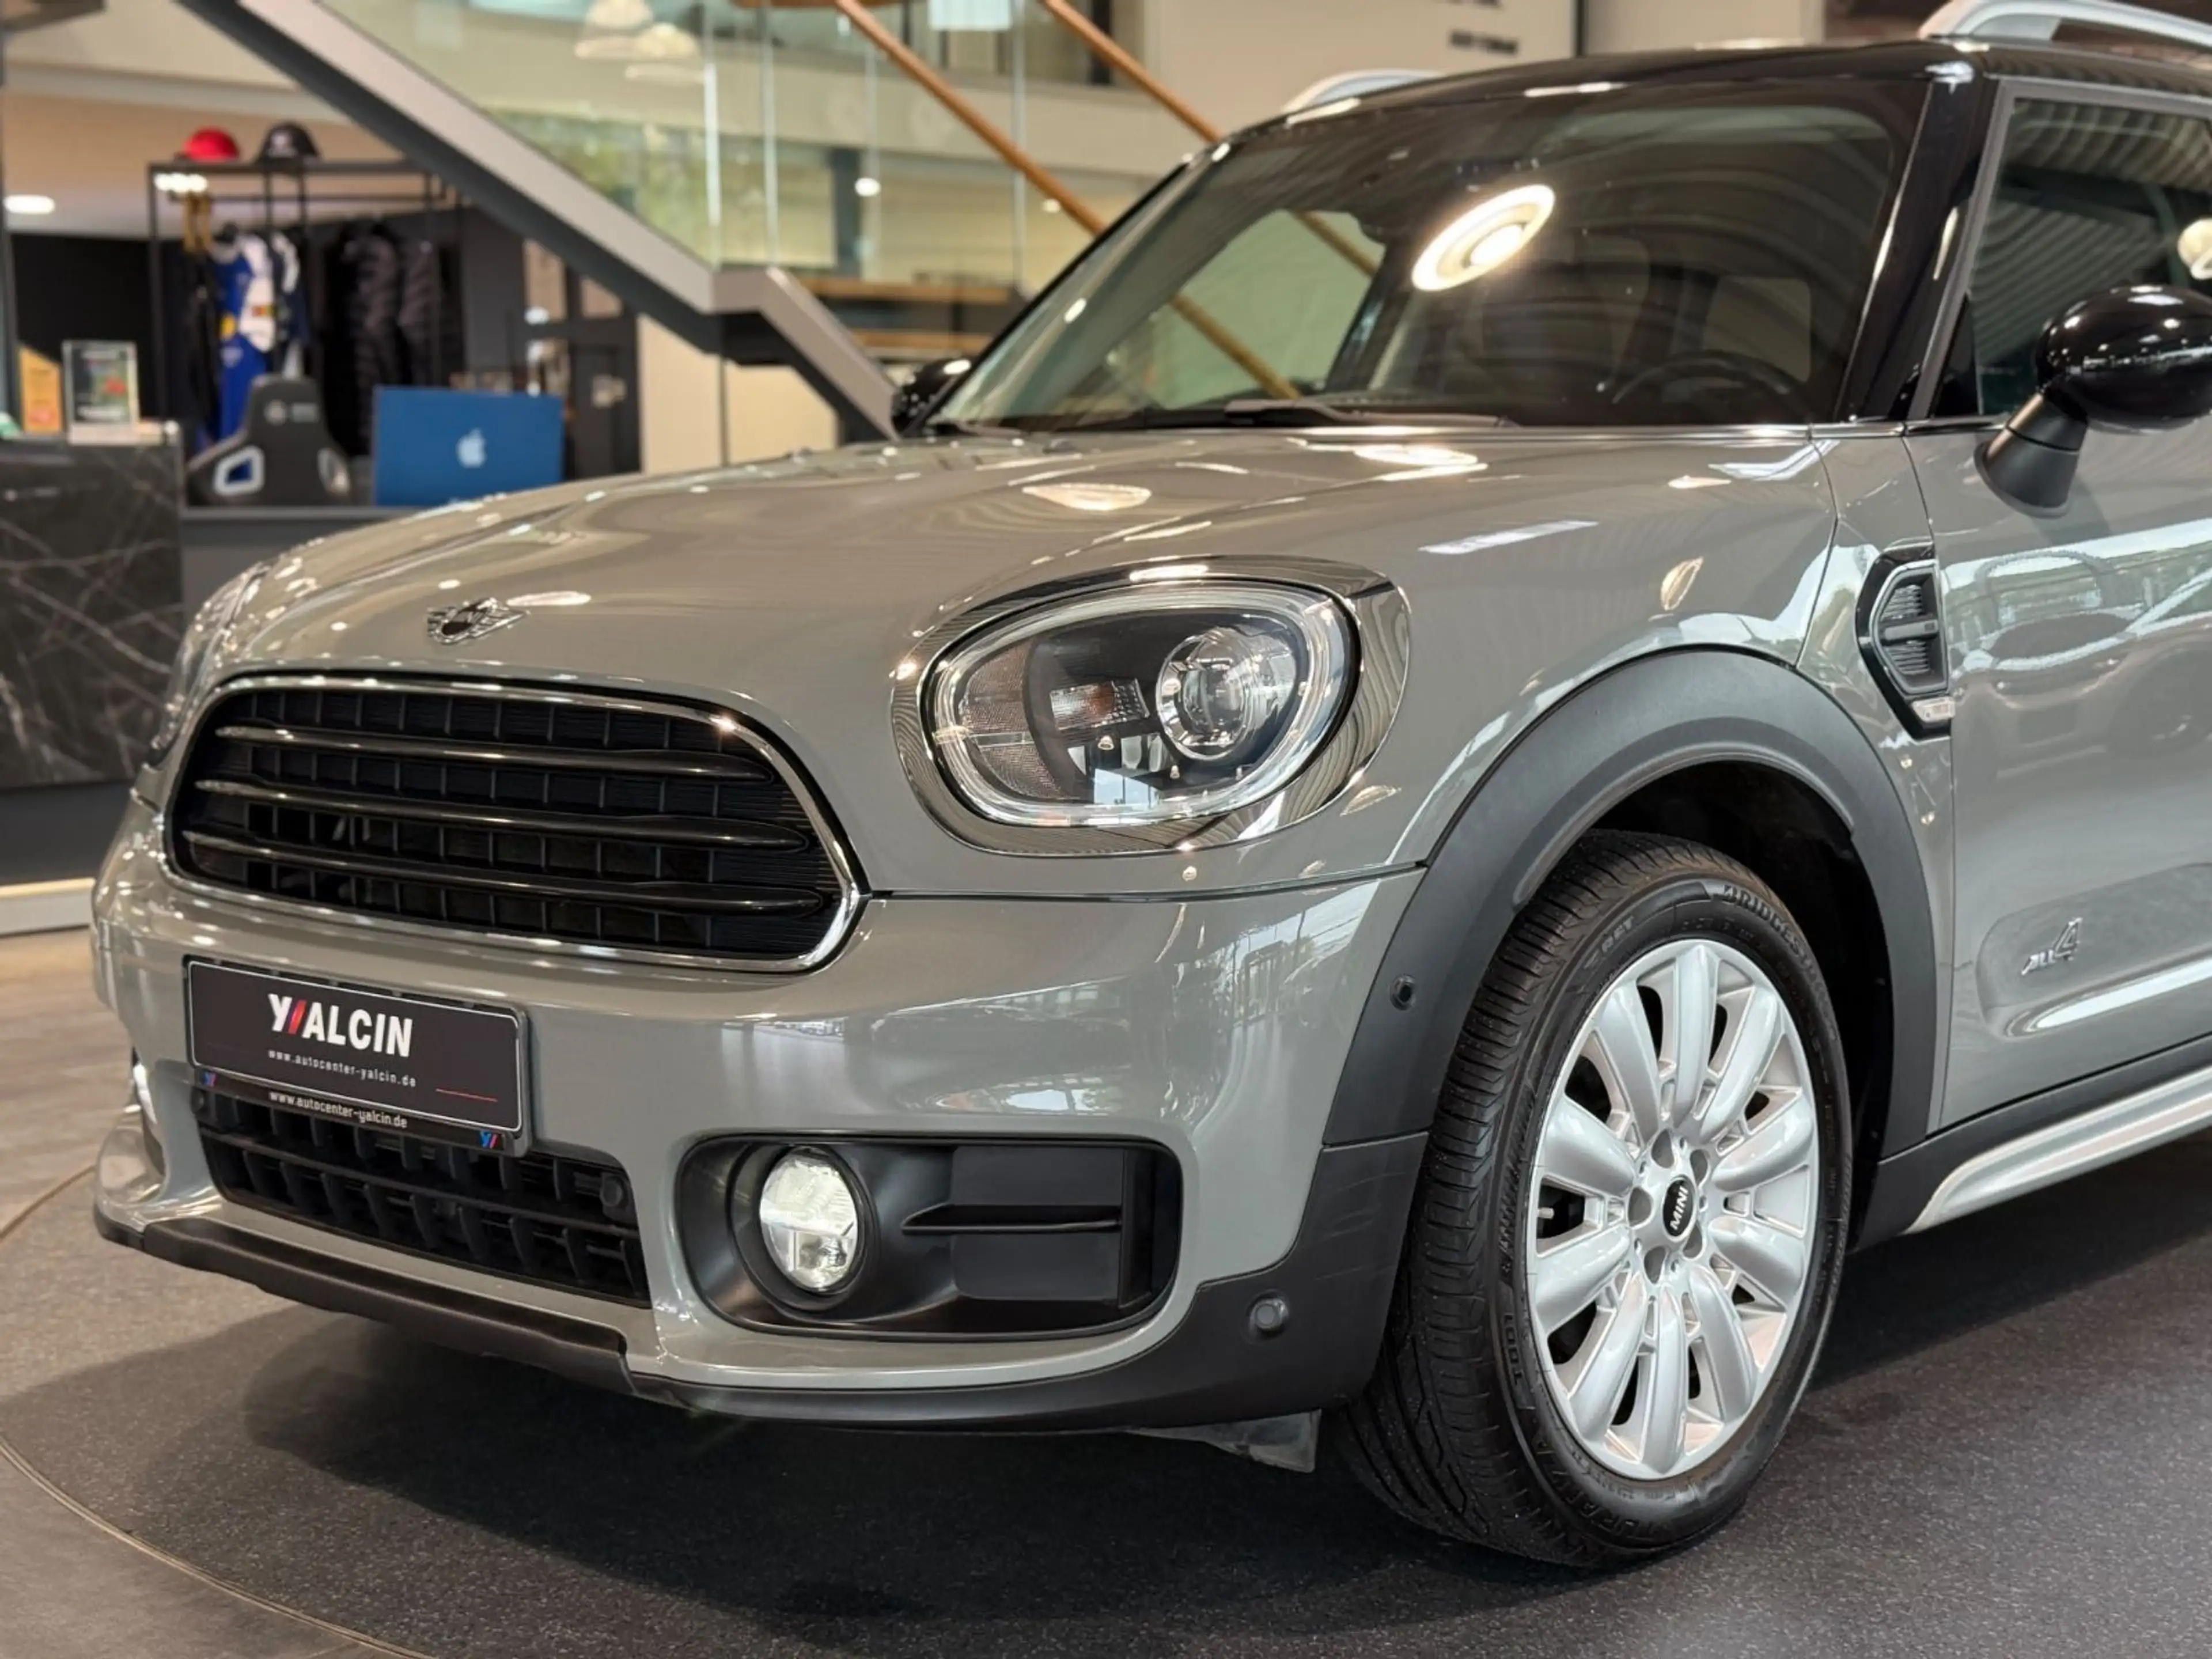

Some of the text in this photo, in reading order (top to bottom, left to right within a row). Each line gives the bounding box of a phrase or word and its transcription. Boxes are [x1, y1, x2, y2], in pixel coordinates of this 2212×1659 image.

[267, 1049, 416, 1087] www.autocenter-yalcin.de
[269, 1091, 408, 1129] www.autocenter-yalcin.de
[1669, 1185, 1689, 1231] MINI
